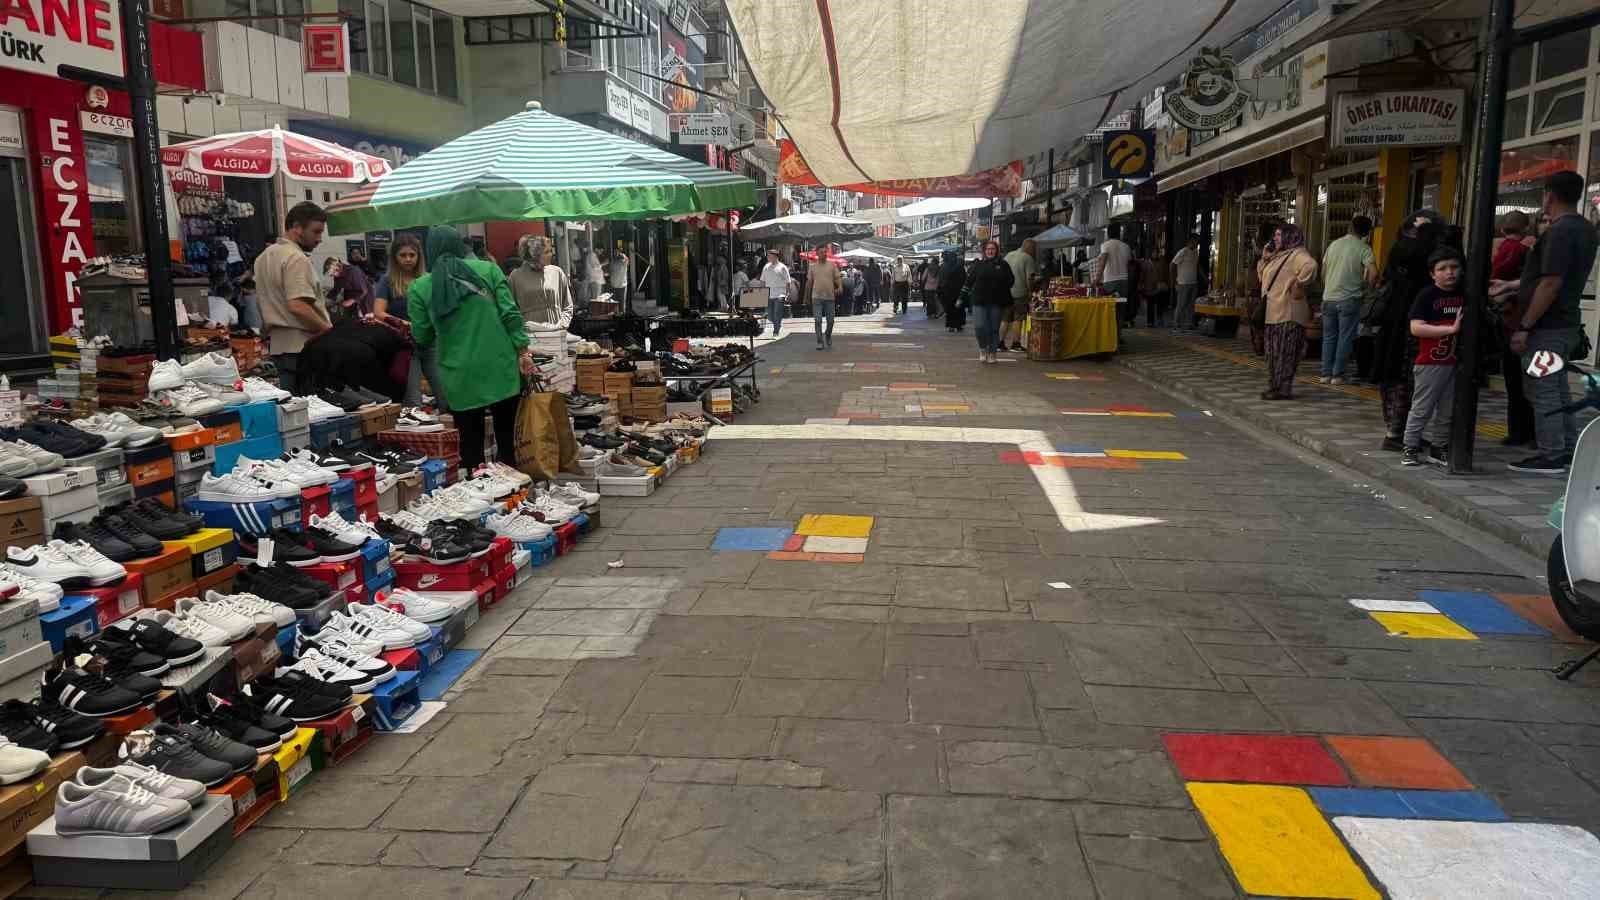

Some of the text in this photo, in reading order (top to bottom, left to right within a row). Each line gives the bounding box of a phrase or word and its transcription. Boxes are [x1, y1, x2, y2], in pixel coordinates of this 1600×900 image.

[320, 37, 343, 62] E
[1346, 95, 1458, 126] ÖNER LOKANTASI
[679, 125, 710, 137] Ahmet
[213, 158, 258, 170] ALGIDA
[299, 163, 341, 175] ALGIDA
